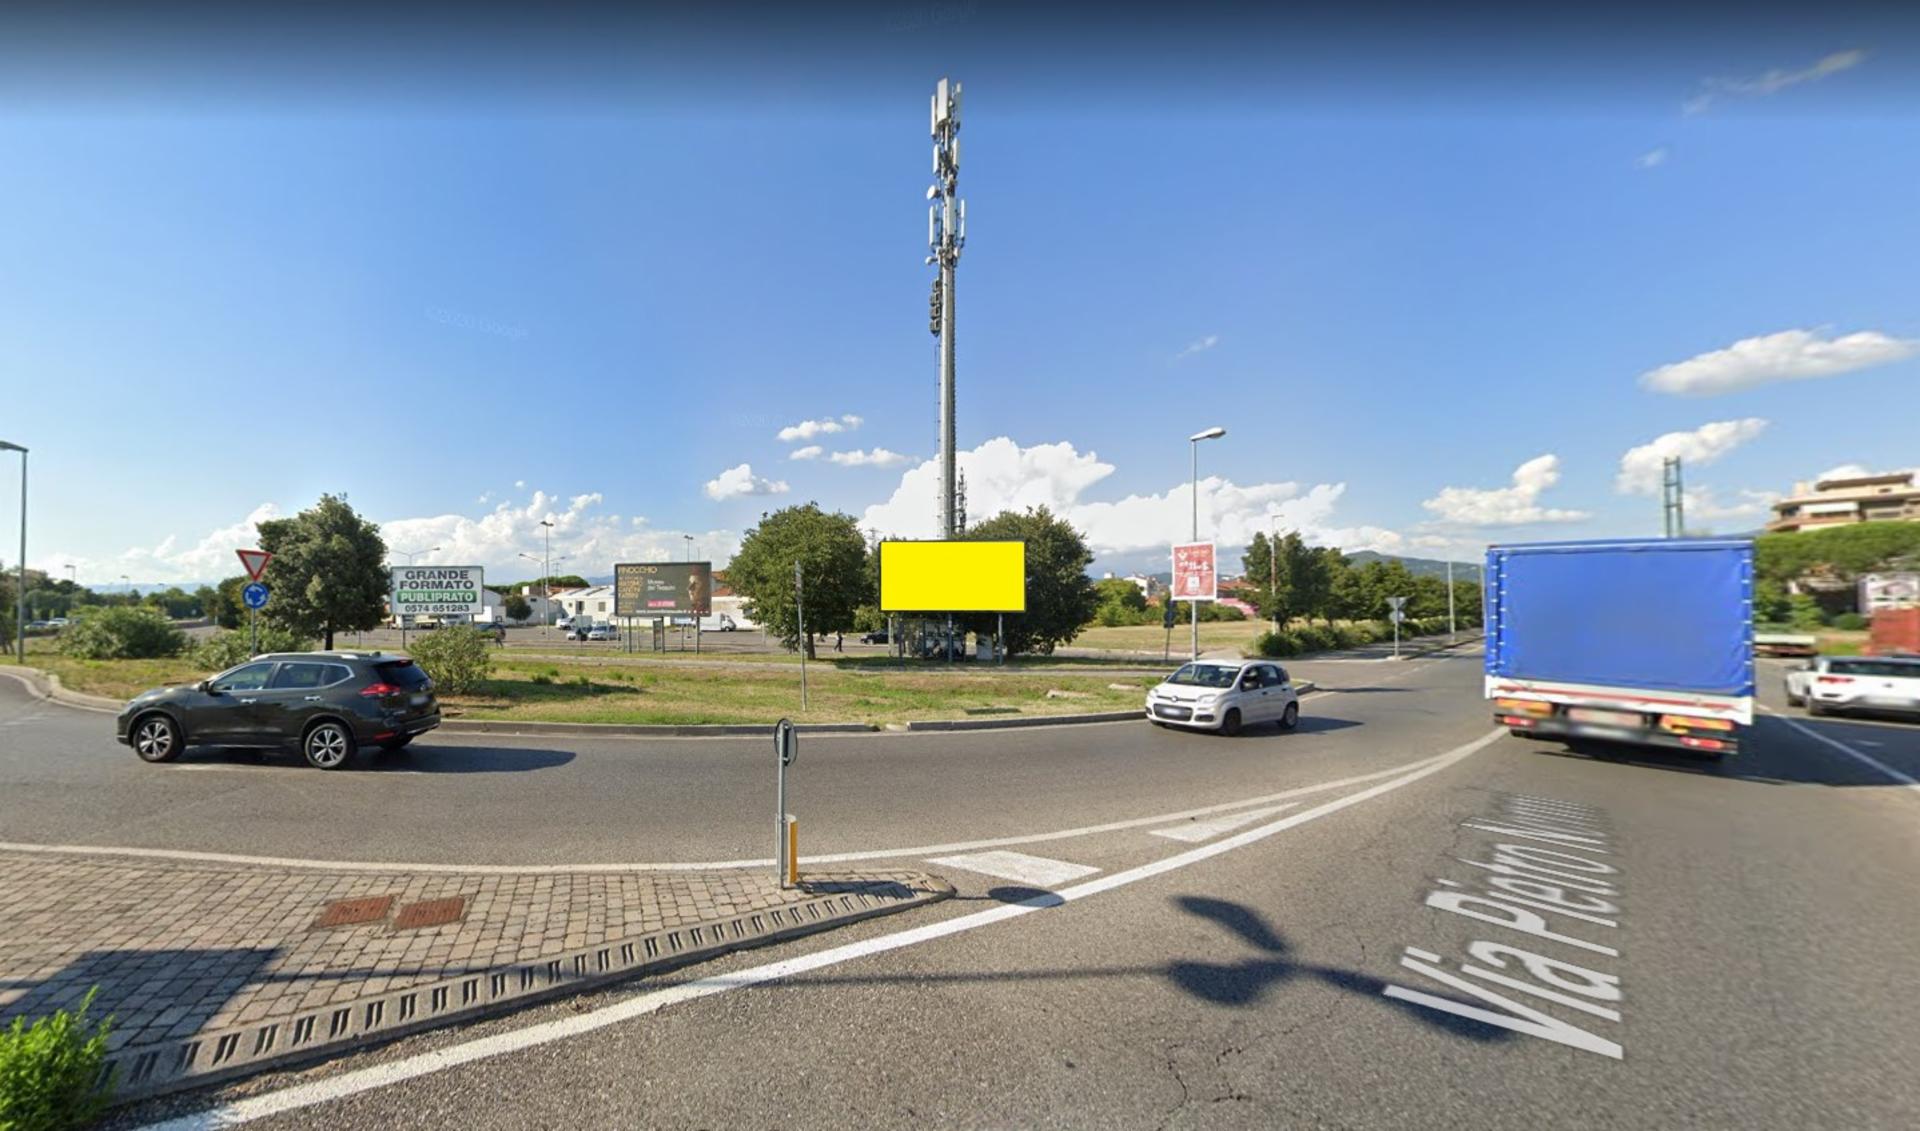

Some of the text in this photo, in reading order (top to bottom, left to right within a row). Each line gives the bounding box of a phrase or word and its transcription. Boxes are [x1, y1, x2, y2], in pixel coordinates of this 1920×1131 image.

[405, 570, 469, 580] GRANDE
[400, 580, 474, 590] FORMATO
[401, 592, 474, 602] PUBLIPRATO
[404, 604, 470, 612] 0574 651283
[1425, 843, 1620, 957] Pietro
[1383, 940, 1623, 1060] Via
